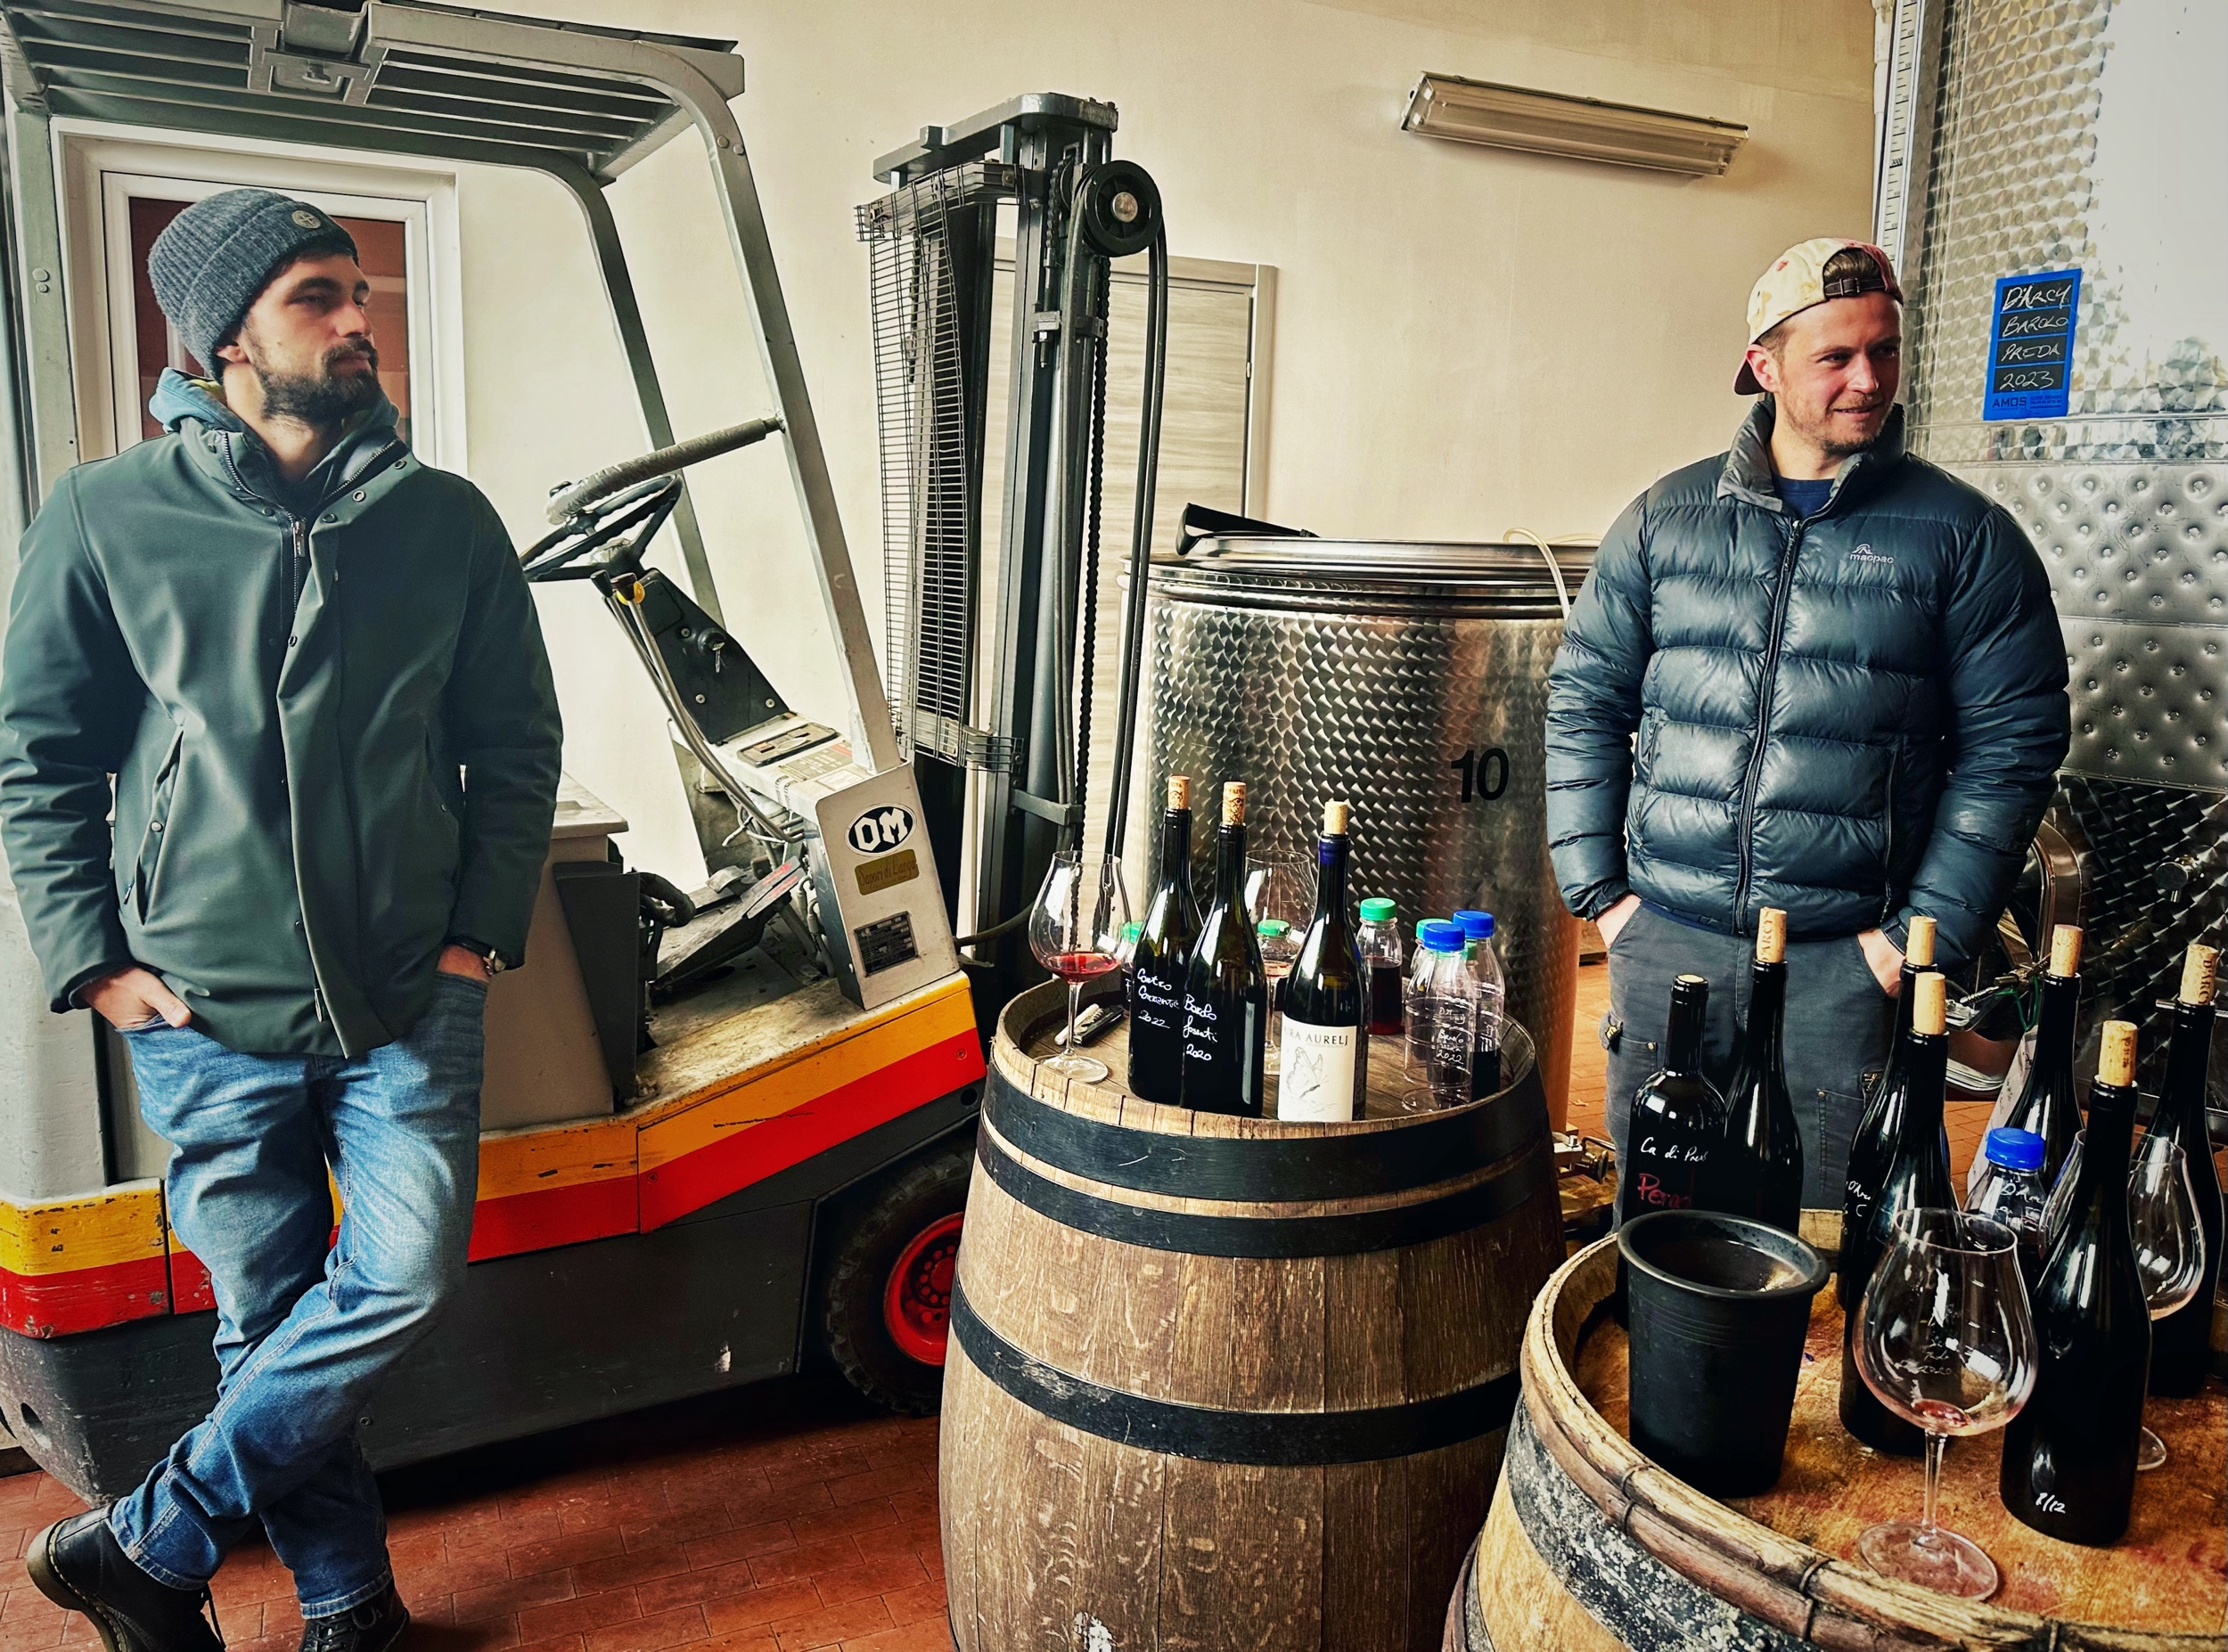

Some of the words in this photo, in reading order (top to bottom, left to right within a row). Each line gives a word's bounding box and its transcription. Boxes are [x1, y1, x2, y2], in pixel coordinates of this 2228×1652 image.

[1999, 371, 2054, 390] 2023
[1992, 397, 2027, 408] AMOS
[1849, 553, 1894, 564] macpac
[1450, 747, 1510, 803] 10
[854, 807, 908, 852] OM
[1185, 1043, 1212, 1060] 2020
